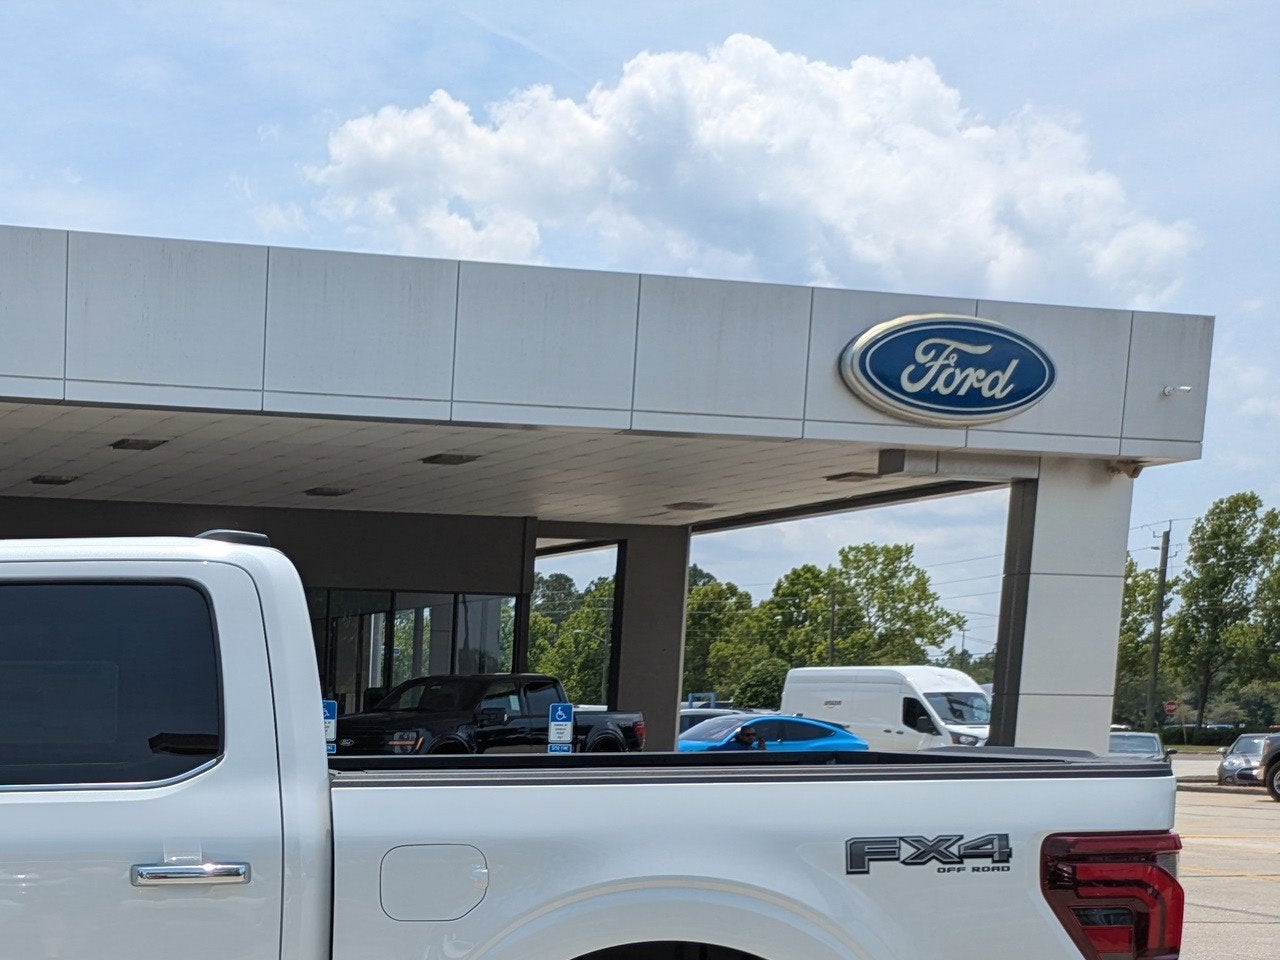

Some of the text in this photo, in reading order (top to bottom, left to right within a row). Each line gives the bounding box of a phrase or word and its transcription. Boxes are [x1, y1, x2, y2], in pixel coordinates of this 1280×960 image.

[900, 337, 1018, 399] Ford
[846, 833, 1012, 875] FX4
[971, 865, 1011, 873] ROAD
